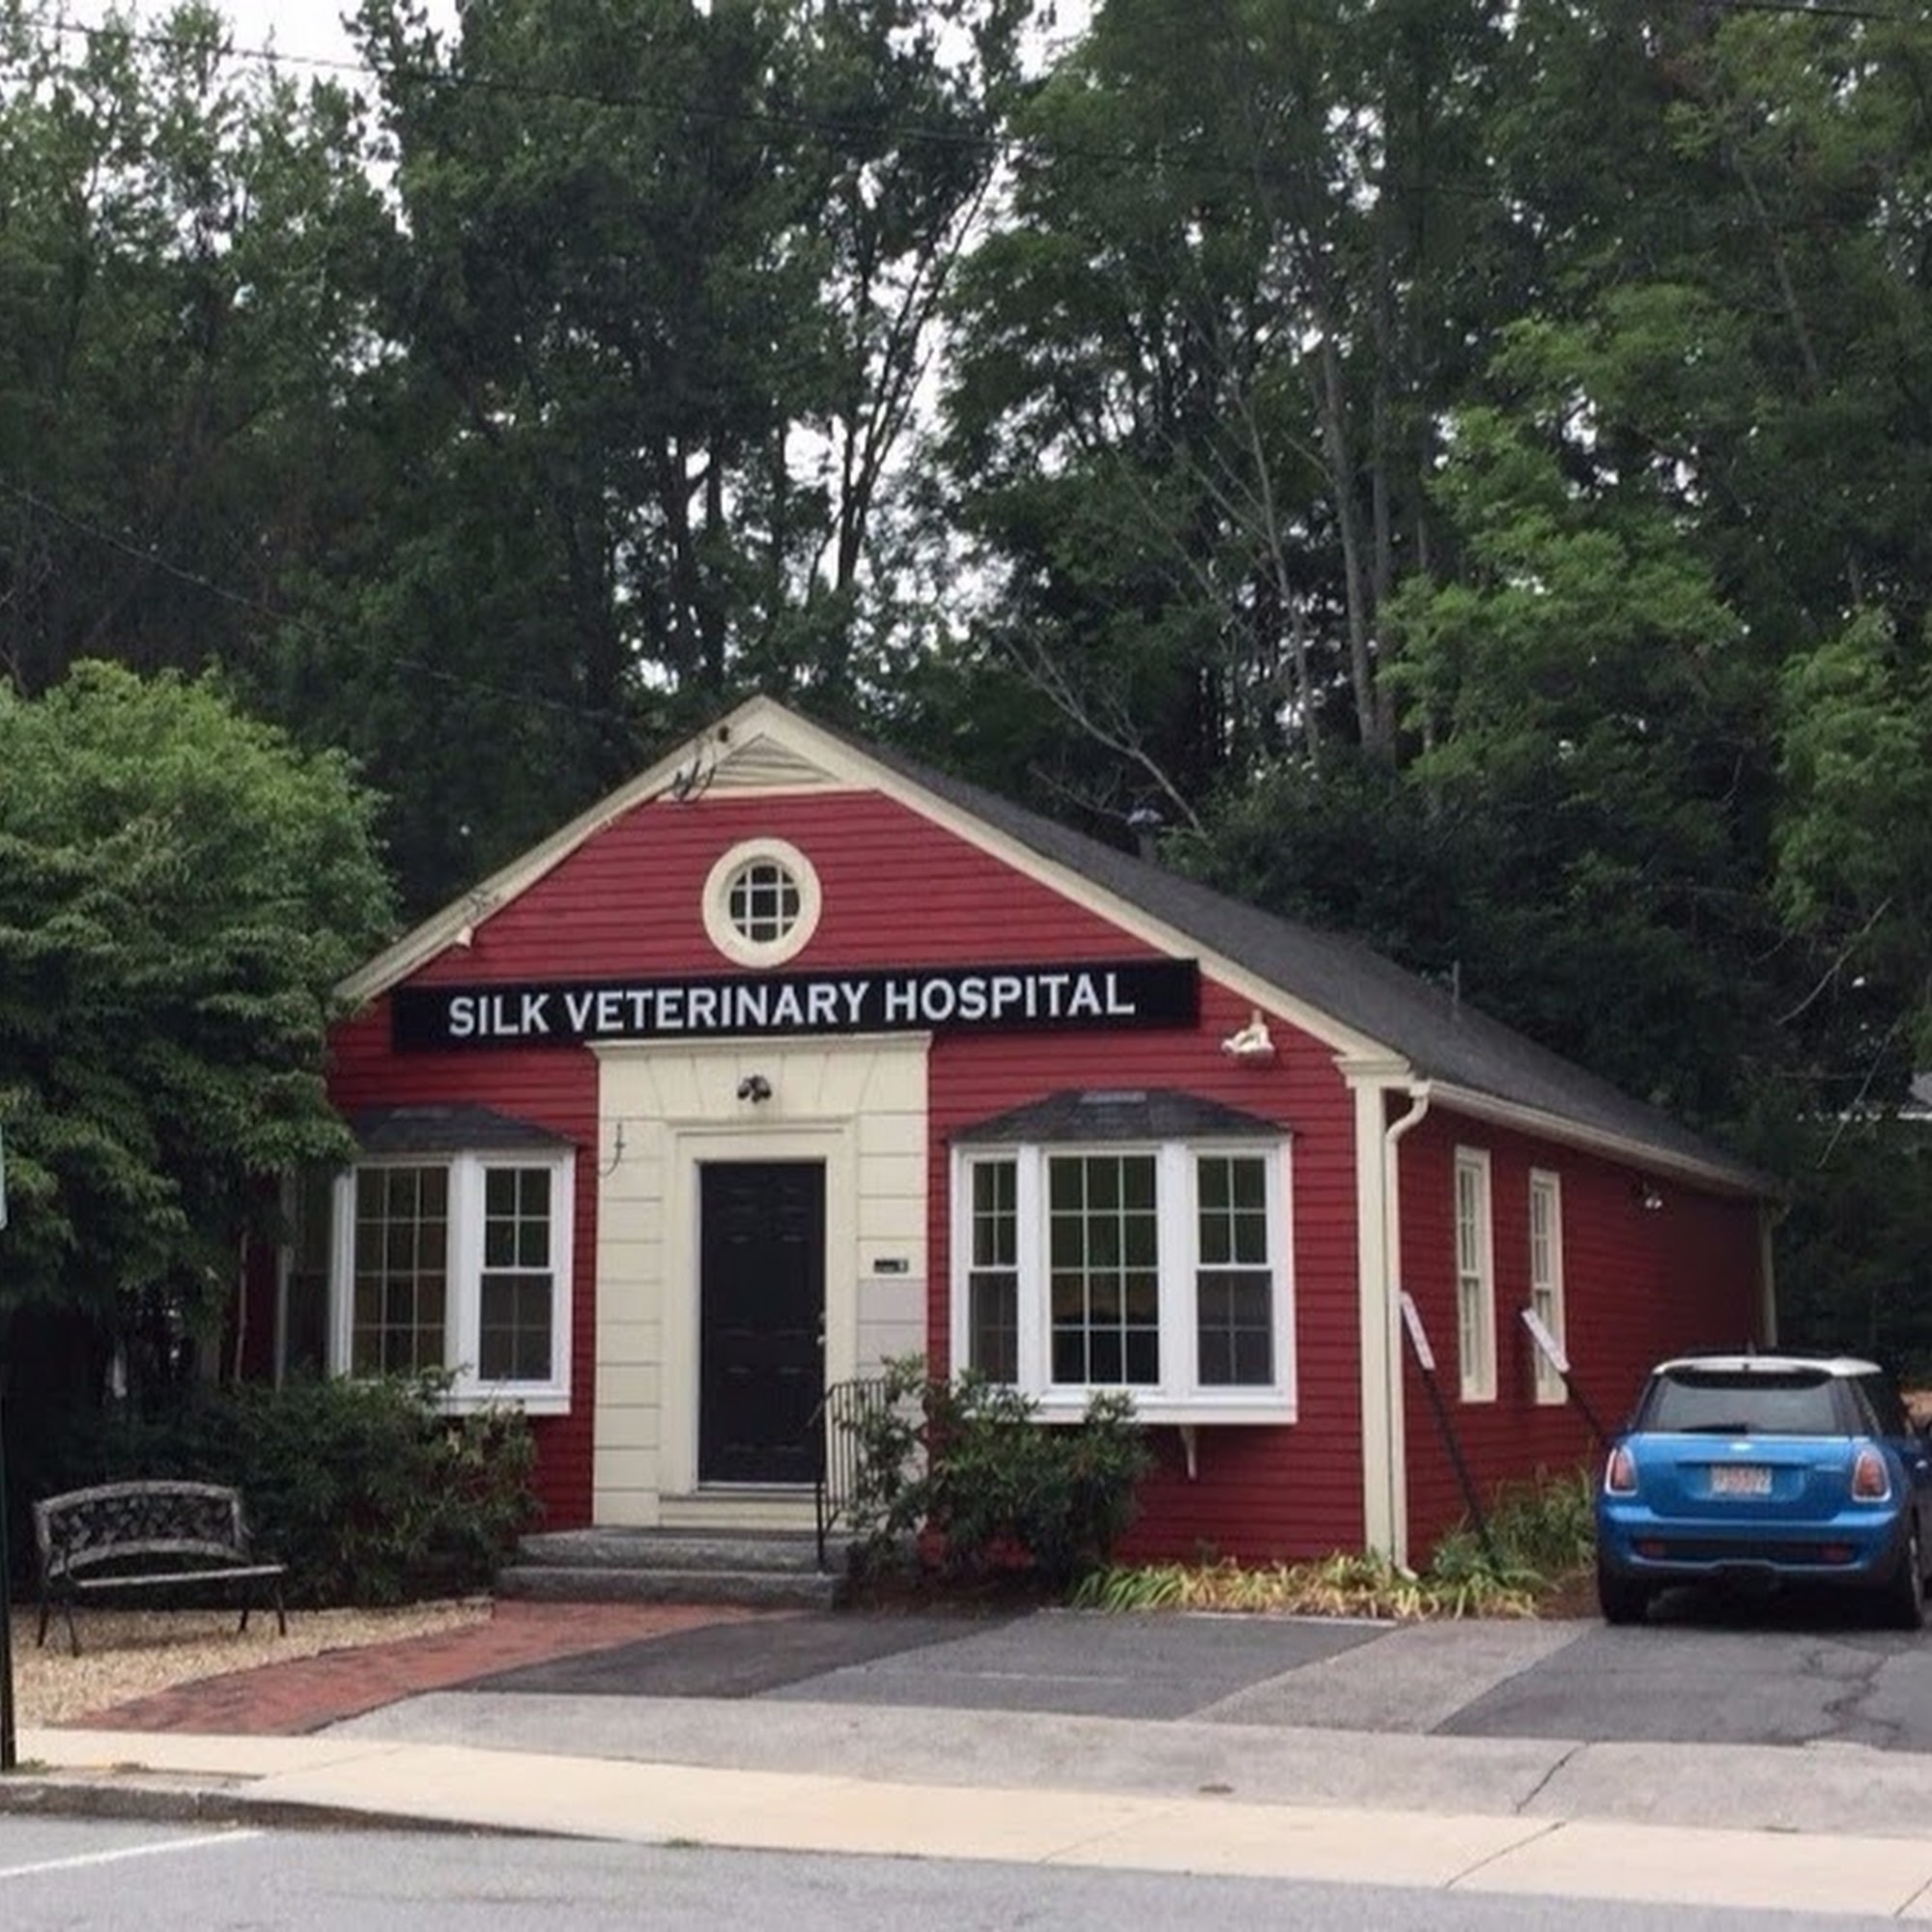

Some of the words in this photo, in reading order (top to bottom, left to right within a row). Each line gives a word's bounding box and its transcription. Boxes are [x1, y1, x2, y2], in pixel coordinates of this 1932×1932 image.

[448, 993, 551, 1037] SILK
[564, 981, 870, 1033] VETERINARY
[885, 972, 1136, 1022] HOSPITAL
